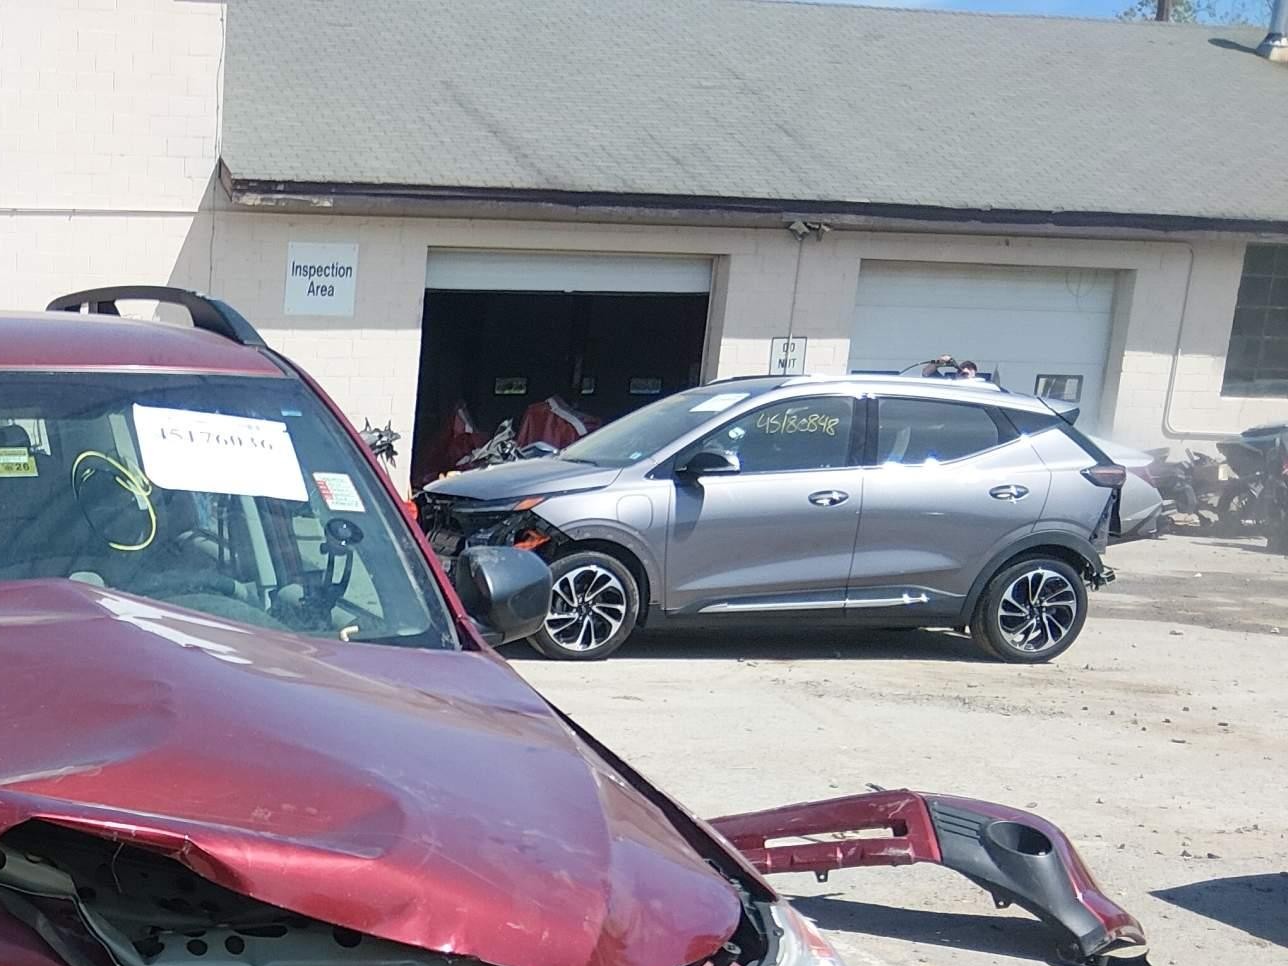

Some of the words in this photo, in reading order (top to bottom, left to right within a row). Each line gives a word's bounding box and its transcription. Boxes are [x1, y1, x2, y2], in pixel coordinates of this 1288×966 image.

[291, 261, 353, 280] Inspection
[306, 280, 335, 296] Area
[756, 412, 840, 436] 45180848
